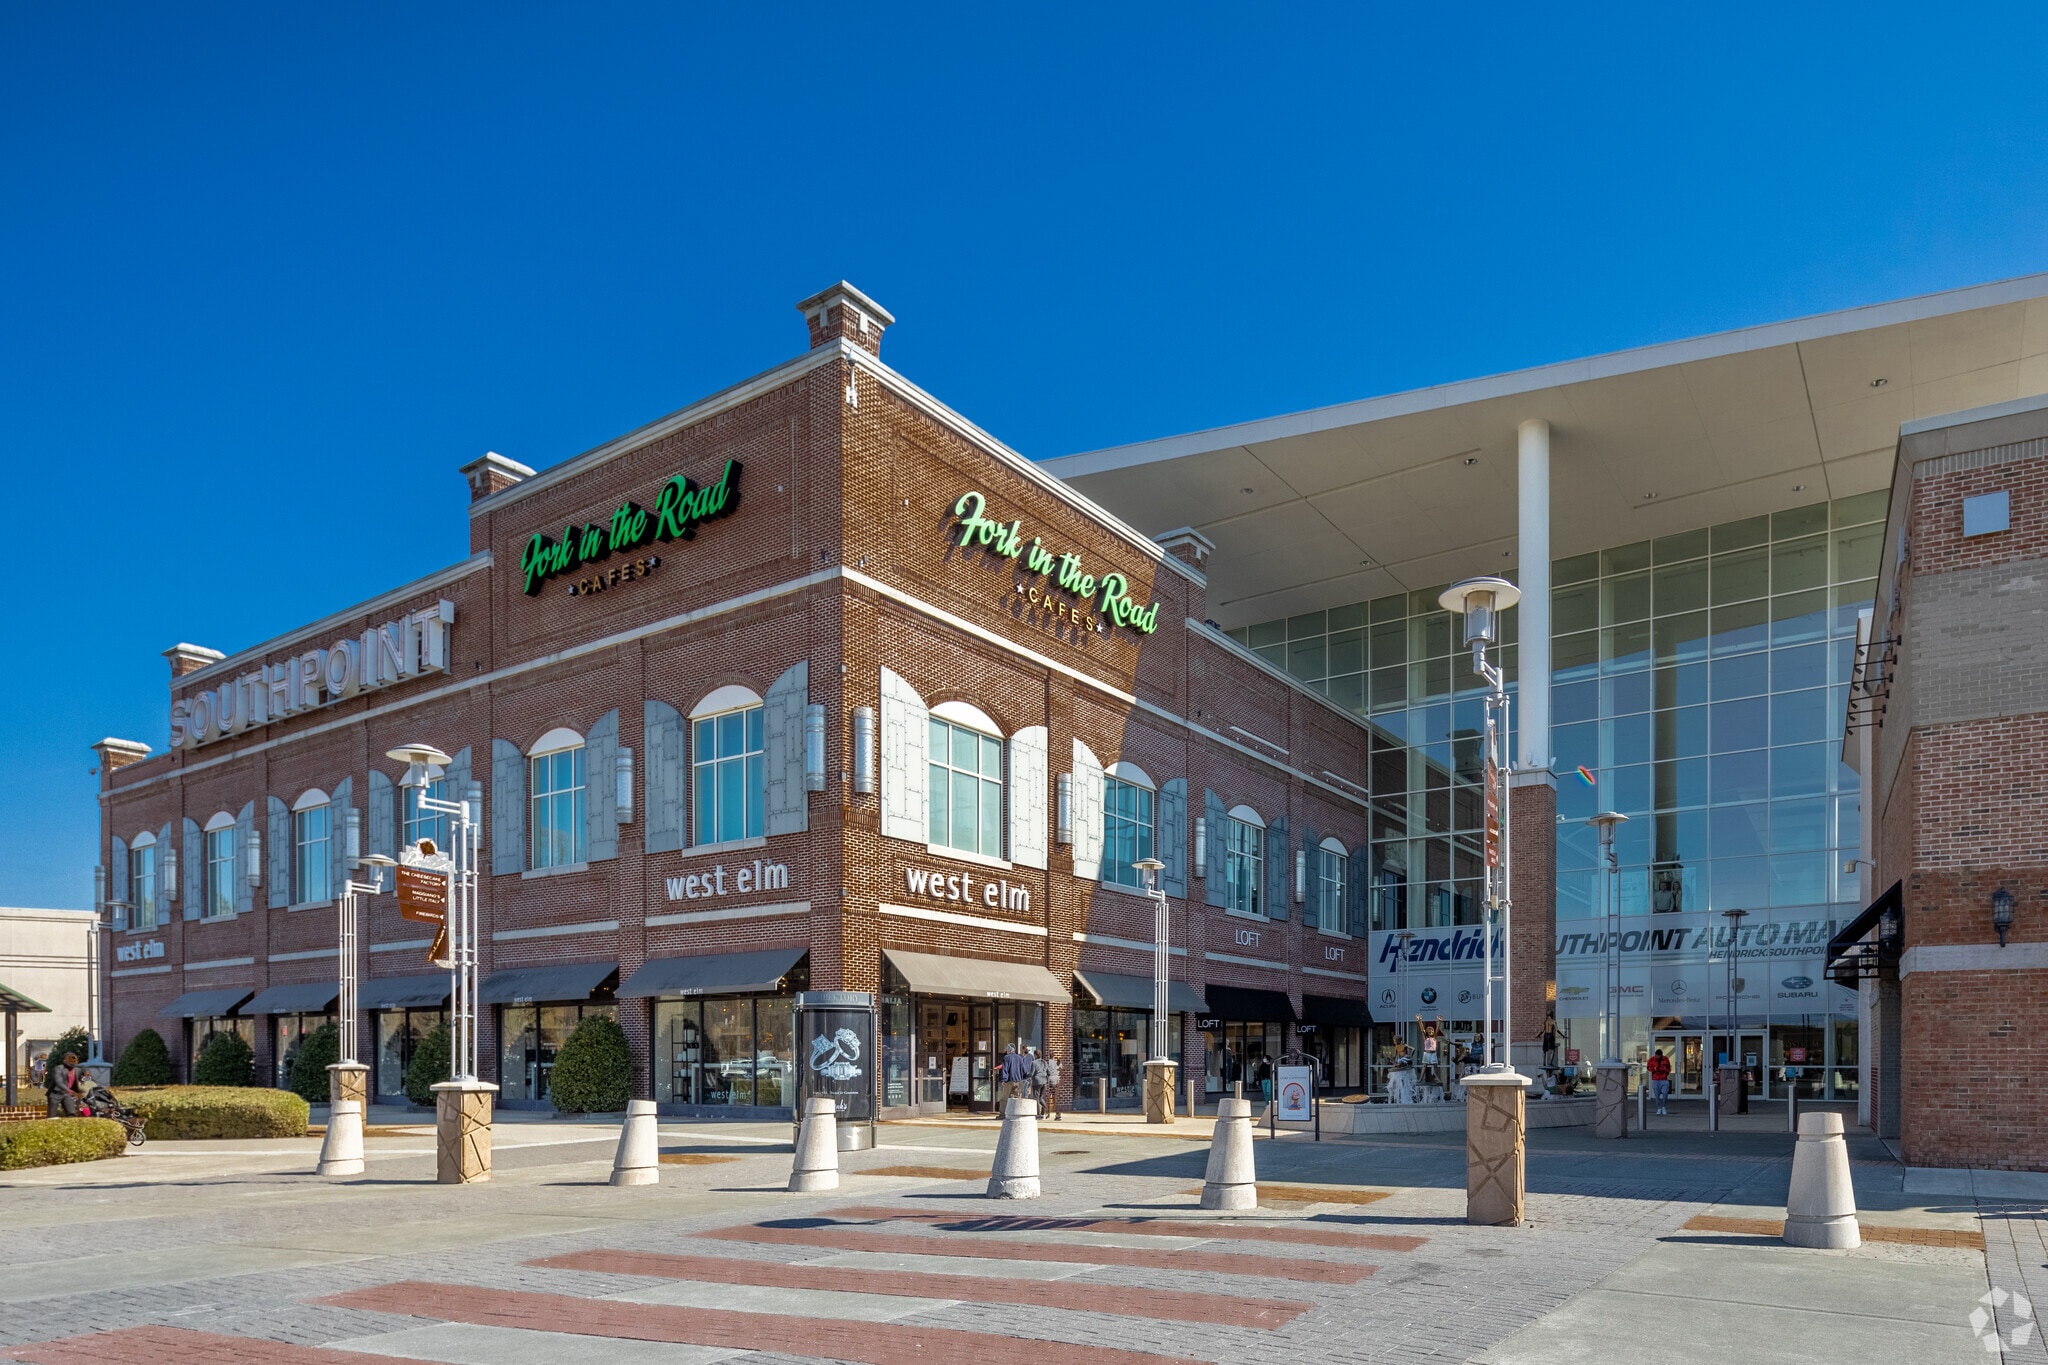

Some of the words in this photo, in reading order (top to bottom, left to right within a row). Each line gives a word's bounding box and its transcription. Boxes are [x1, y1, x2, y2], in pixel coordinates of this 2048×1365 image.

[521, 525, 575, 594] Fork
[579, 523, 603, 561] in
[609, 501, 648, 551] the
[655, 459, 734, 539] Road
[955, 491, 1023, 558] Fork
[1028, 537, 1056, 575] in
[1059, 552, 1096, 598] the
[1101, 572, 1160, 634] Road
[579, 559, 646, 596] CAFES
[1029, 587, 1093, 632] CAFES
[169, 600, 454, 750] SOUTHPOINT
[666, 864, 728, 901] west
[737, 859, 788, 892] elm
[905, 867, 974, 903] west
[983, 879, 1030, 912] elm
[1235, 929, 1260, 948] LOFT
[1556, 928, 1692, 955] UTHPOINT
[1691, 924, 1781, 949] AUTO
[1782, 920, 1850, 945] MA
[116, 940, 143, 962] west
[143, 939, 165, 959] elm
[1325, 946, 1345, 962] LOFT
[1709, 946, 1828, 959] HENDRICKSOUTHPOI
[1607, 985, 1645, 993] GMC
[1777, 991, 1819, 999] SUBARU
[1197, 1019, 1220, 1028] LOFT
[1296, 1024, 1317, 1033] LOFT
[710, 1090, 729, 1099] west
